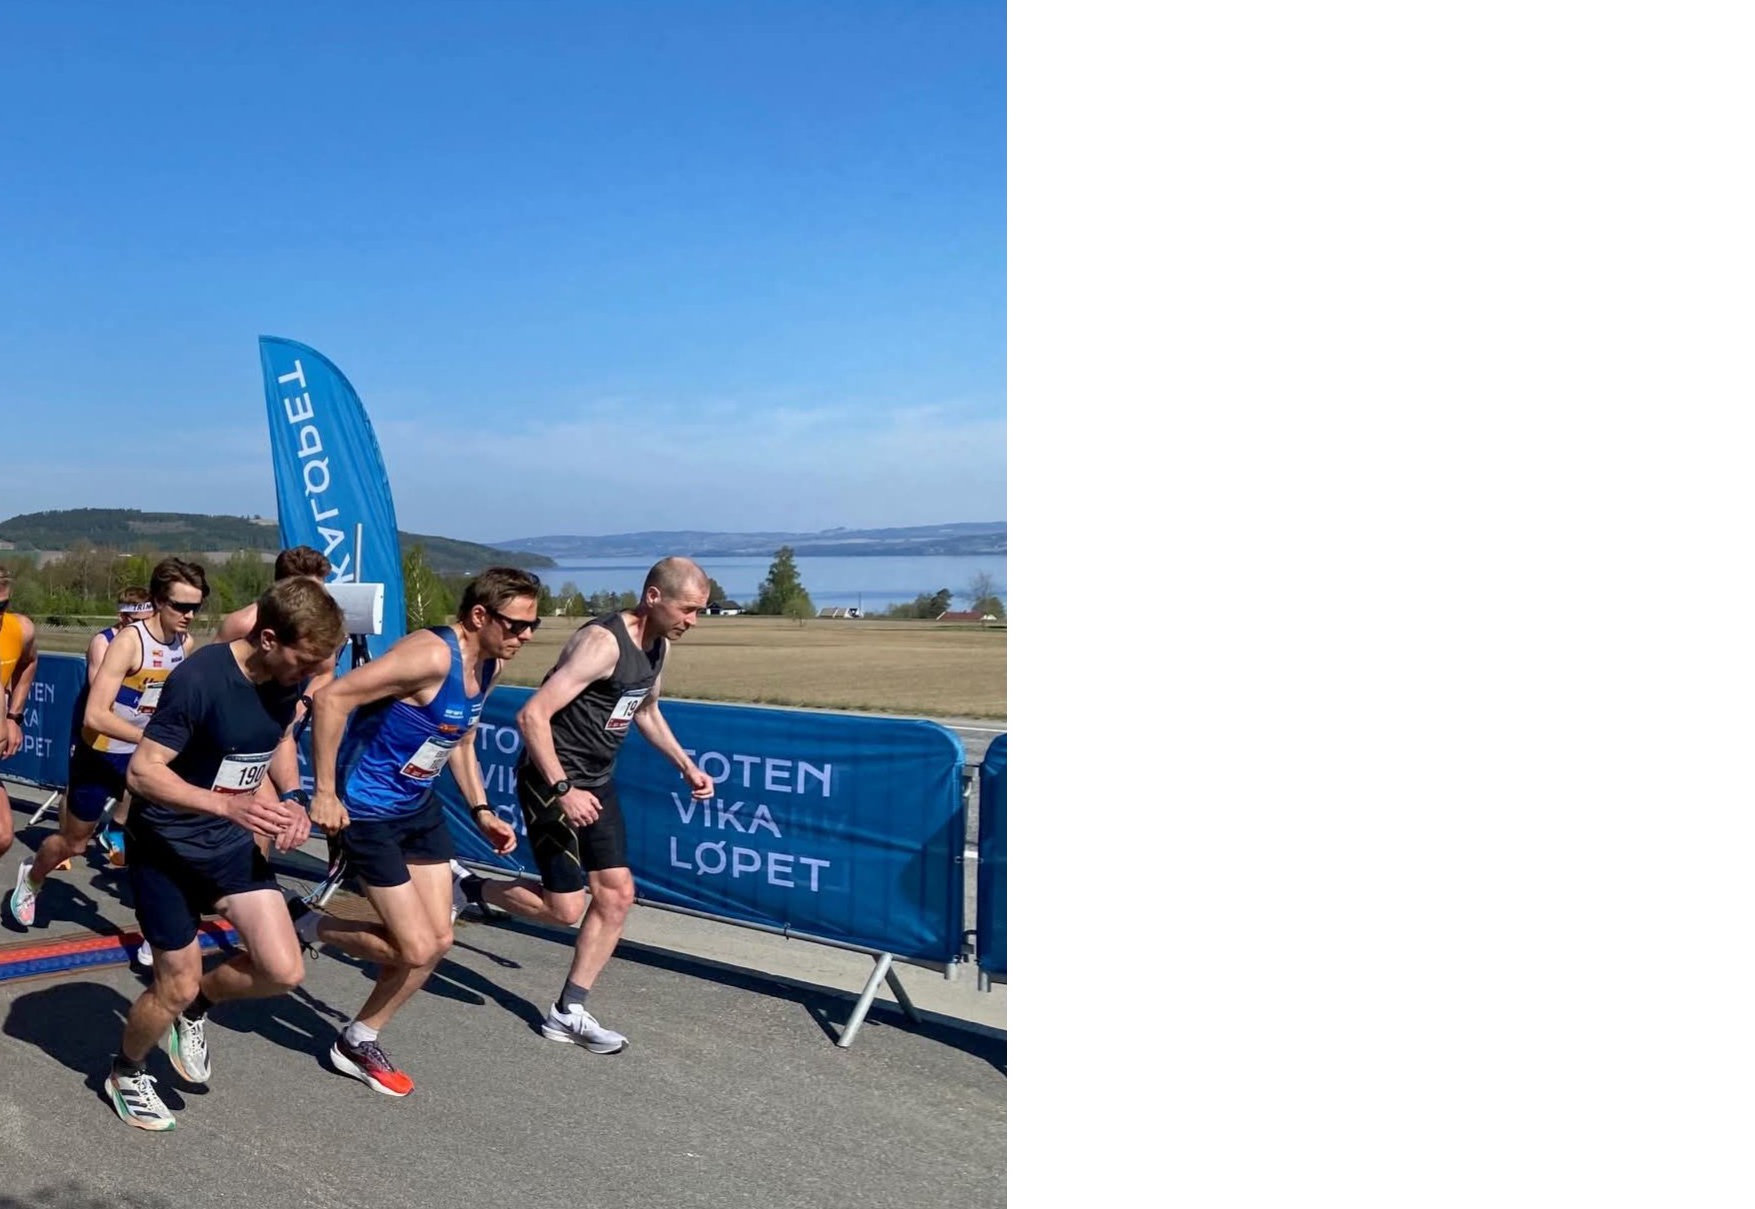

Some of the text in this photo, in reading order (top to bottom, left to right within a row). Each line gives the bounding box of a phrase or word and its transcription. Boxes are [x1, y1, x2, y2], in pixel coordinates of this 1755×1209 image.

[623, 699, 638, 717] 19
[24, 735, 52, 758] PET
[238, 763, 266, 786] 190
[671, 791, 783, 838] VIKA
[670, 836, 831, 892] LØPET
